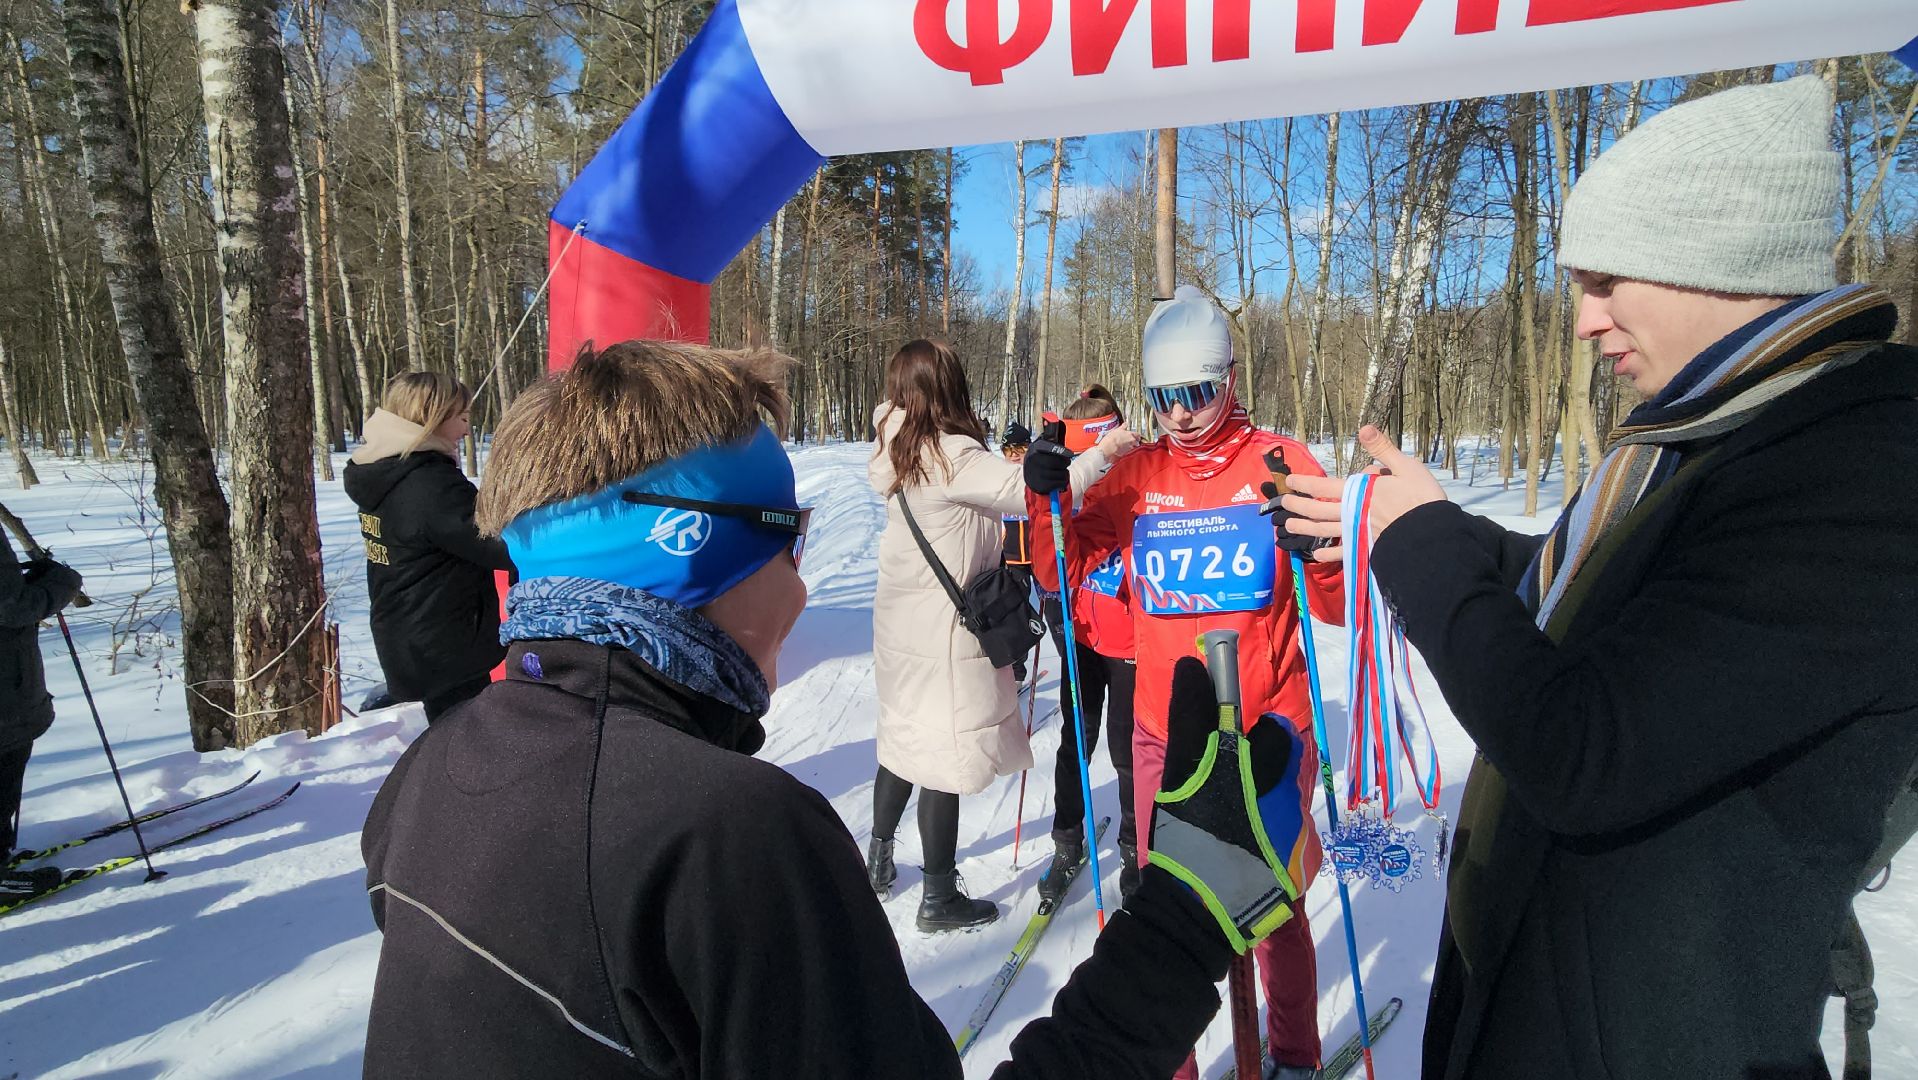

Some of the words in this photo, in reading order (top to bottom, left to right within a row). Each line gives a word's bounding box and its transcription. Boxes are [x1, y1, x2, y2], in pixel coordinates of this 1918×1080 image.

[1231, 492, 1258, 504] adidas
[1157, 515, 1226, 529] ФЕСТИВАЛЬ
[1146, 527, 1196, 538] ЛЫЖНОГО
[1198, 523, 1239, 535] СПОРТА
[1145, 542, 1255, 583] 0726
